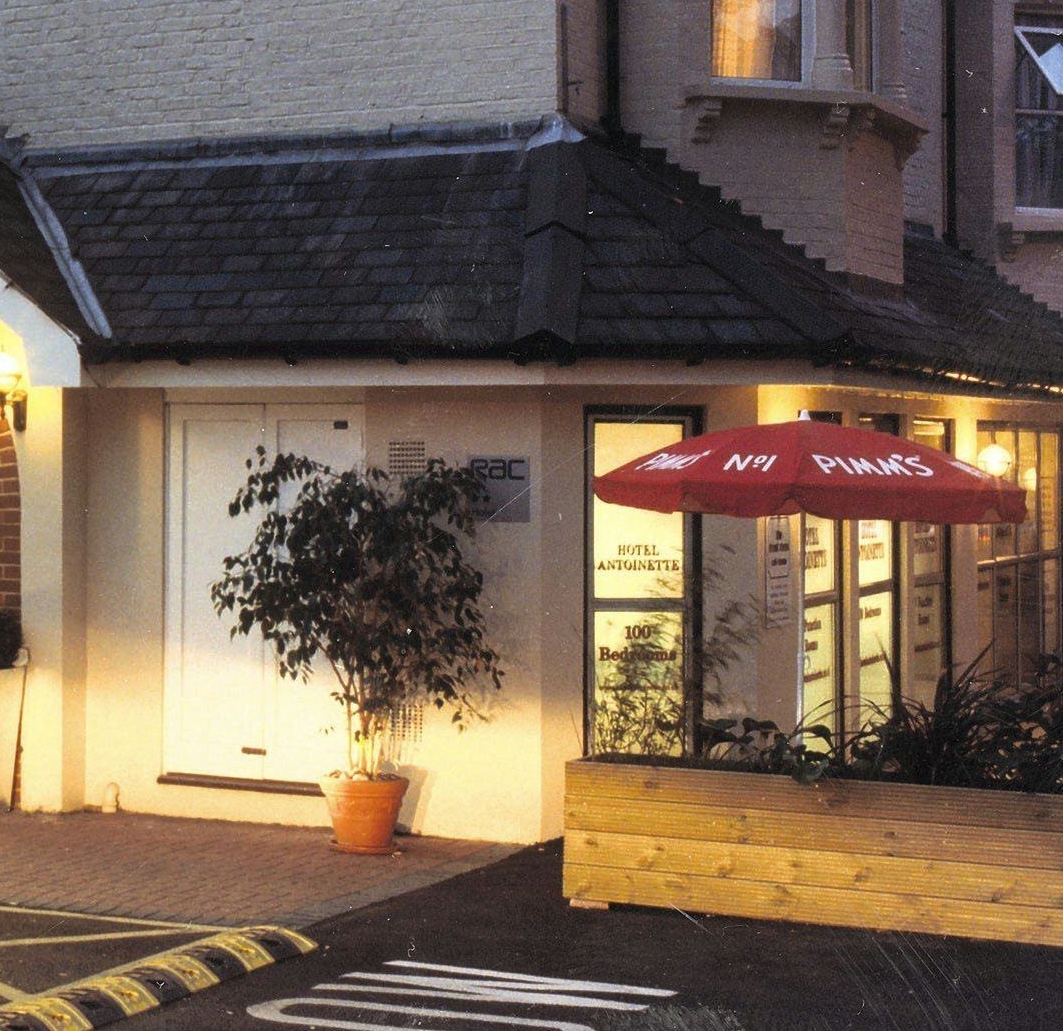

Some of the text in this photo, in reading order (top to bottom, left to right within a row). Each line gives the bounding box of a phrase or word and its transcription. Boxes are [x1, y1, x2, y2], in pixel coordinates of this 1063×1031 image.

[811, 453, 935, 478] PIMM'S
[617, 544, 660, 556] HOTEL
[597, 559, 680, 571] ANTOINETTE
[624, 624, 651, 640] 100
